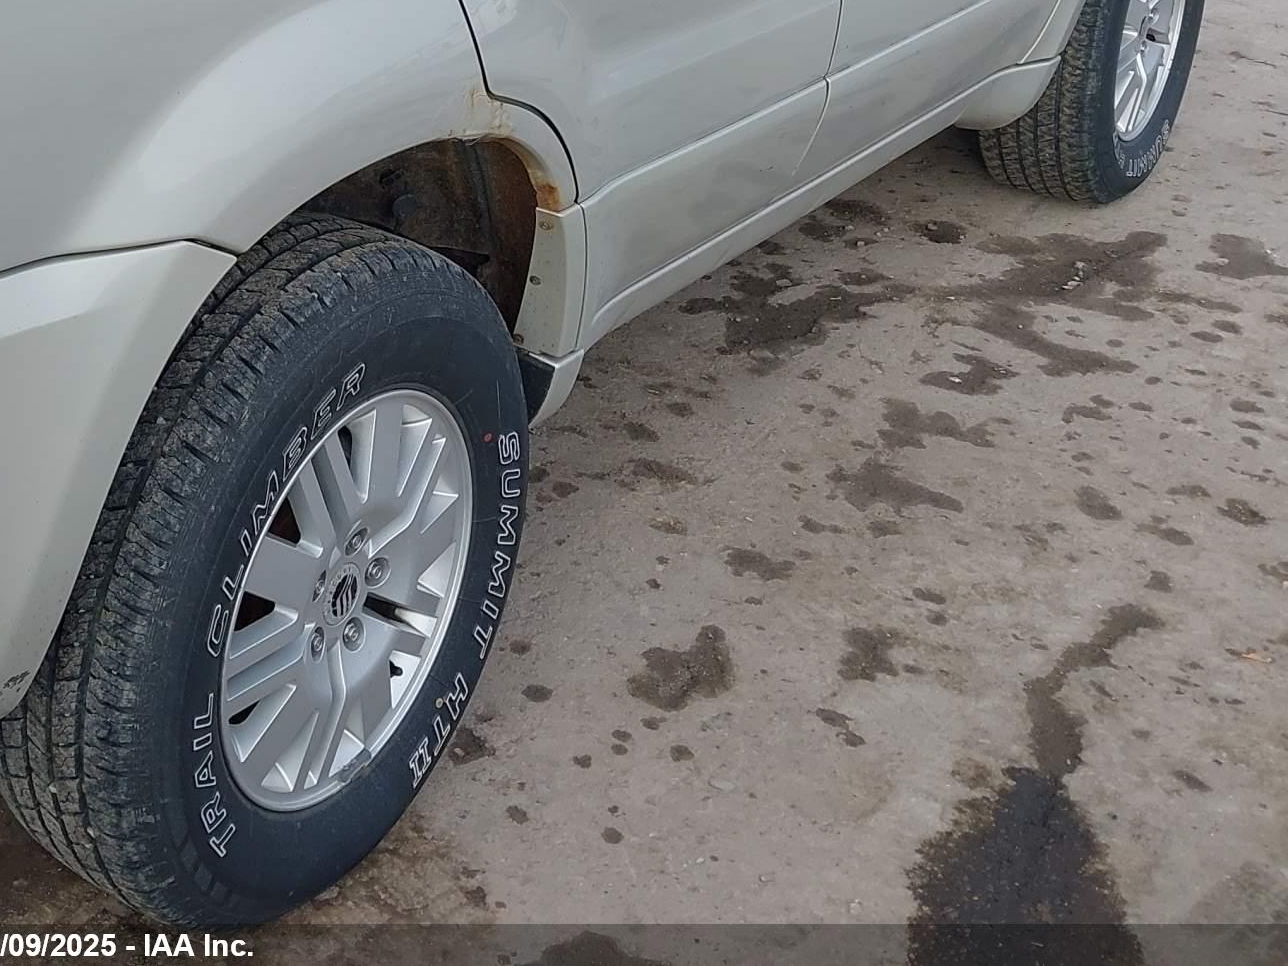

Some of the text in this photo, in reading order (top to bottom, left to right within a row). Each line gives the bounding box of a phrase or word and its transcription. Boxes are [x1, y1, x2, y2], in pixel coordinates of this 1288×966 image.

[193, 363, 365, 857] TRAIL CLIMBER
[473, 431, 521, 660] SUMMIT
